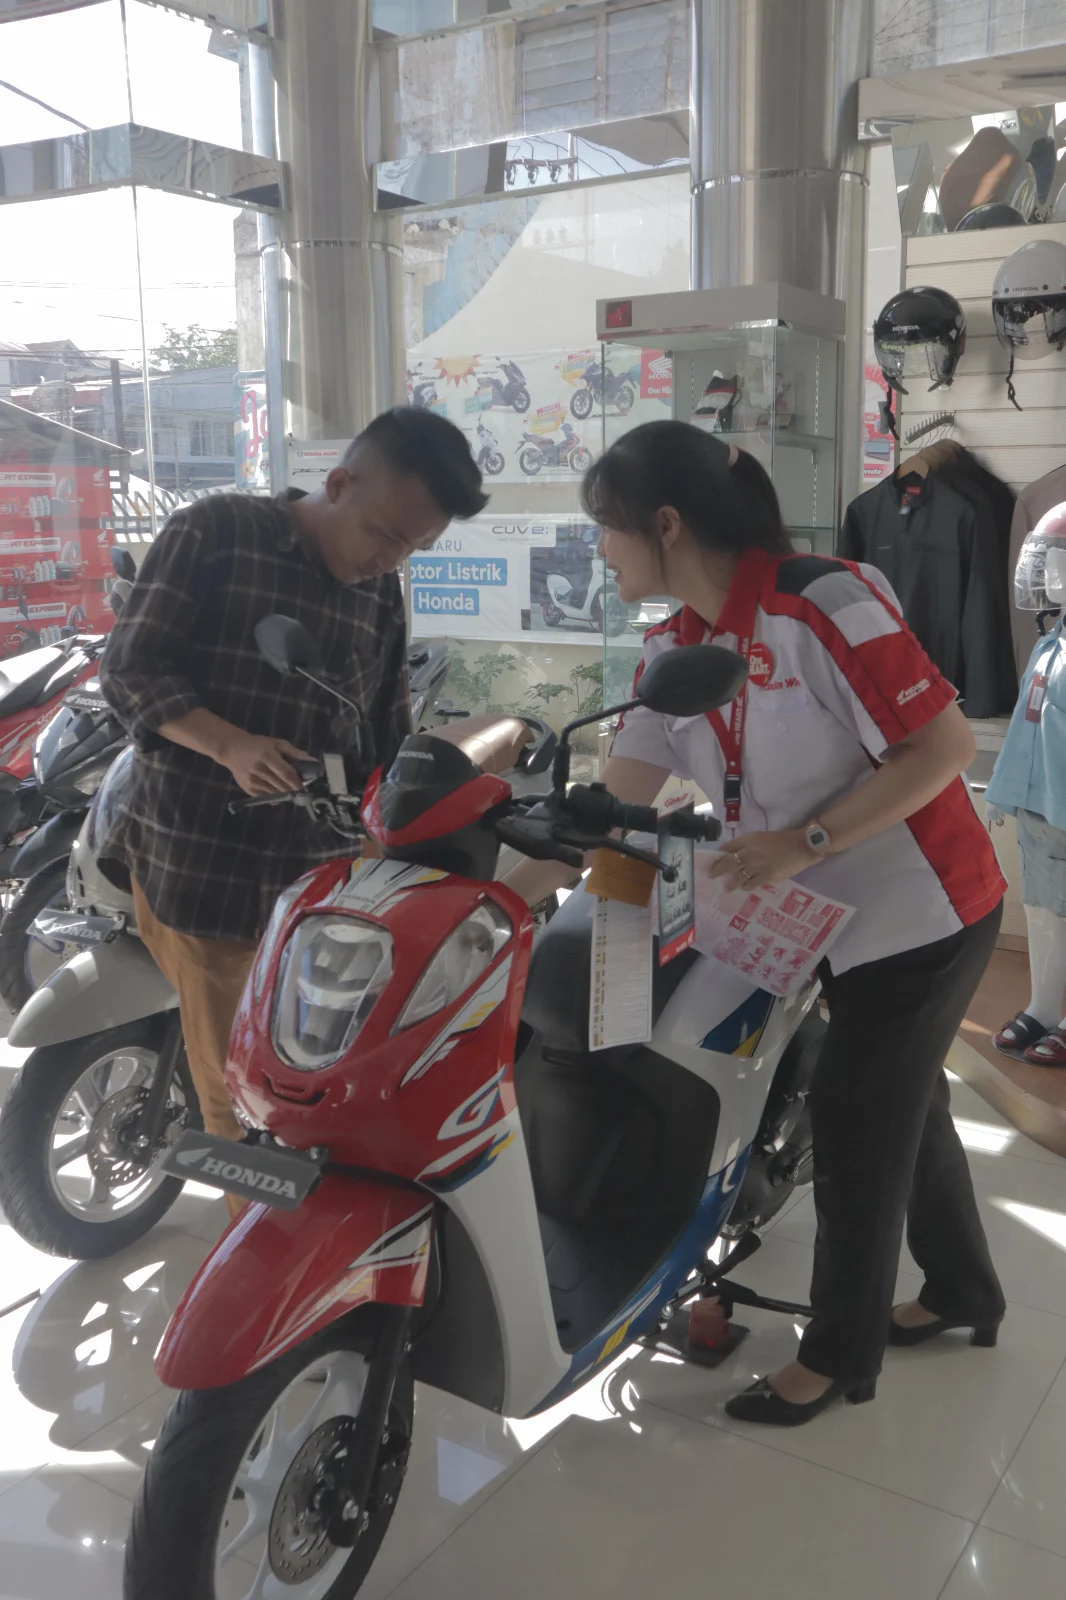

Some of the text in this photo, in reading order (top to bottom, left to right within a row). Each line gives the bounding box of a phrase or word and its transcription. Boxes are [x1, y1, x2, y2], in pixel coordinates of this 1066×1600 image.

[892, 324, 920, 332] HONDA
[447, 562, 502, 581] Listrik
[418, 591, 475, 611] Honda
[50, 922, 102, 941] HONDA
[199, 1156, 297, 1199] HONDA
